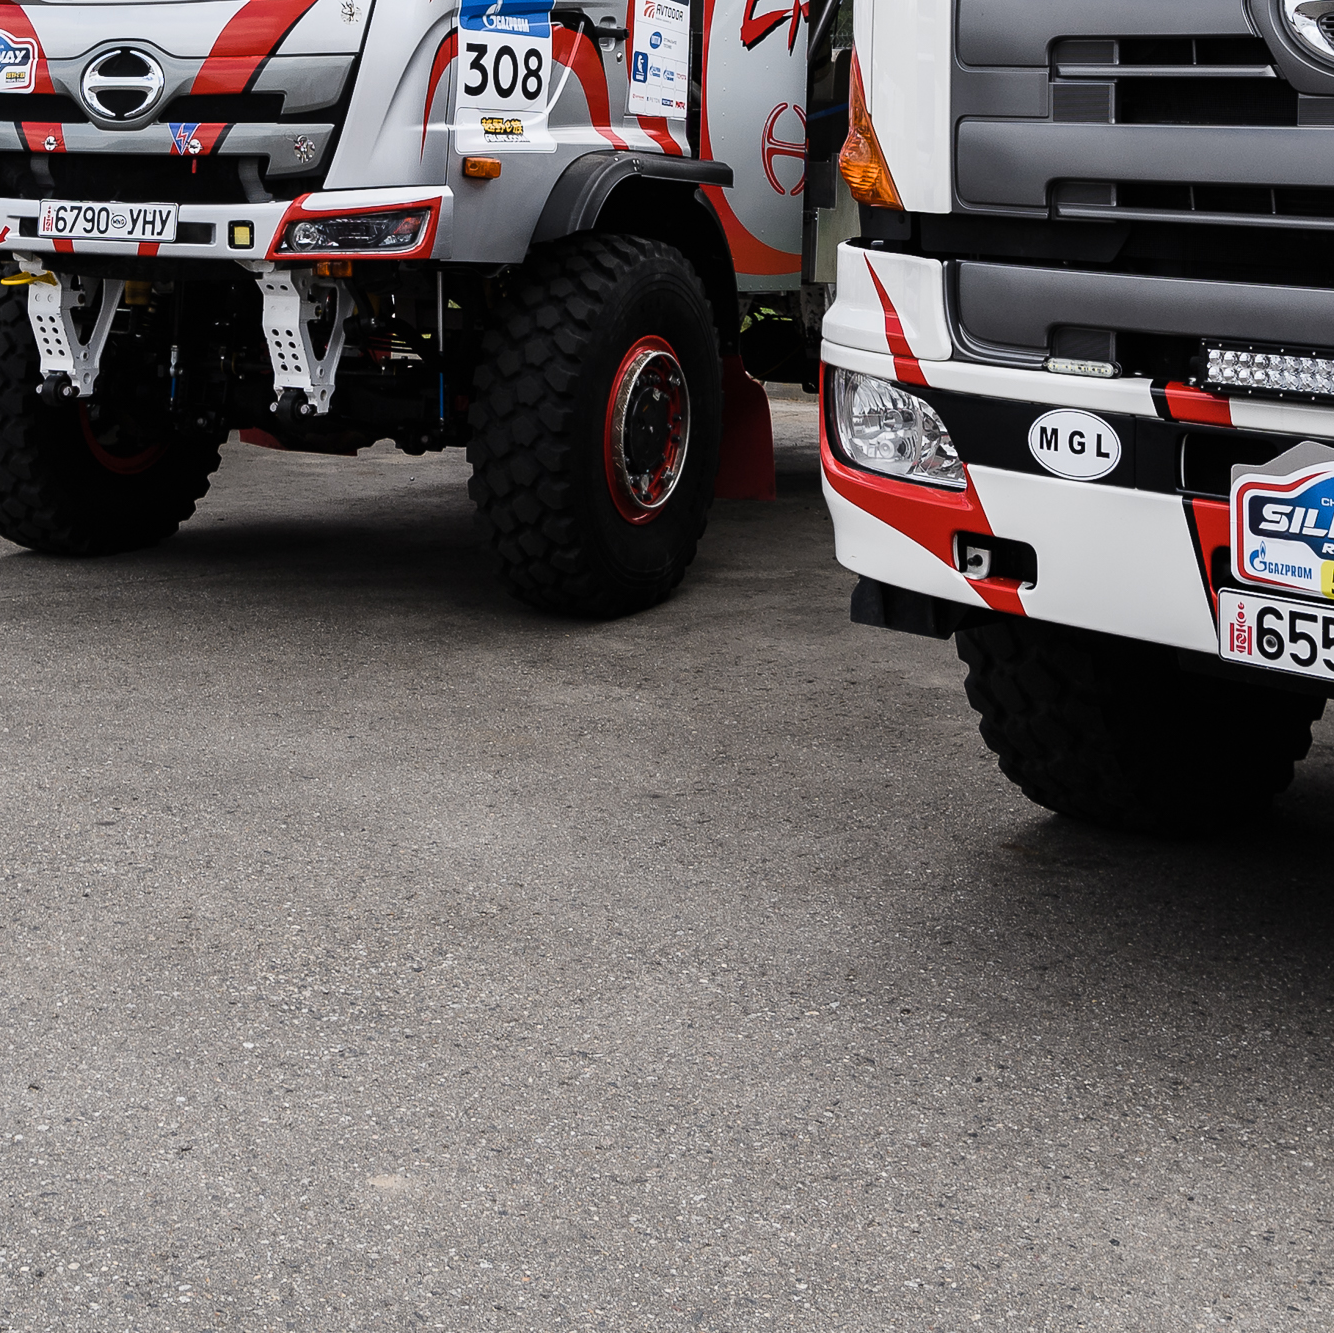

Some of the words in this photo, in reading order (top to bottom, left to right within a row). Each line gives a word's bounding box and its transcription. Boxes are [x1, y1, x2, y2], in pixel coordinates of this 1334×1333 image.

[495, 15, 530, 33] GAZPROM
[656, 3, 684, 22] AVTODOR
[464, 42, 543, 101] 308
[54, 205, 110, 235] 6790
[1038, 425, 1110, 460] MGL
[1268, 562, 1313, 580] GAZPROM
